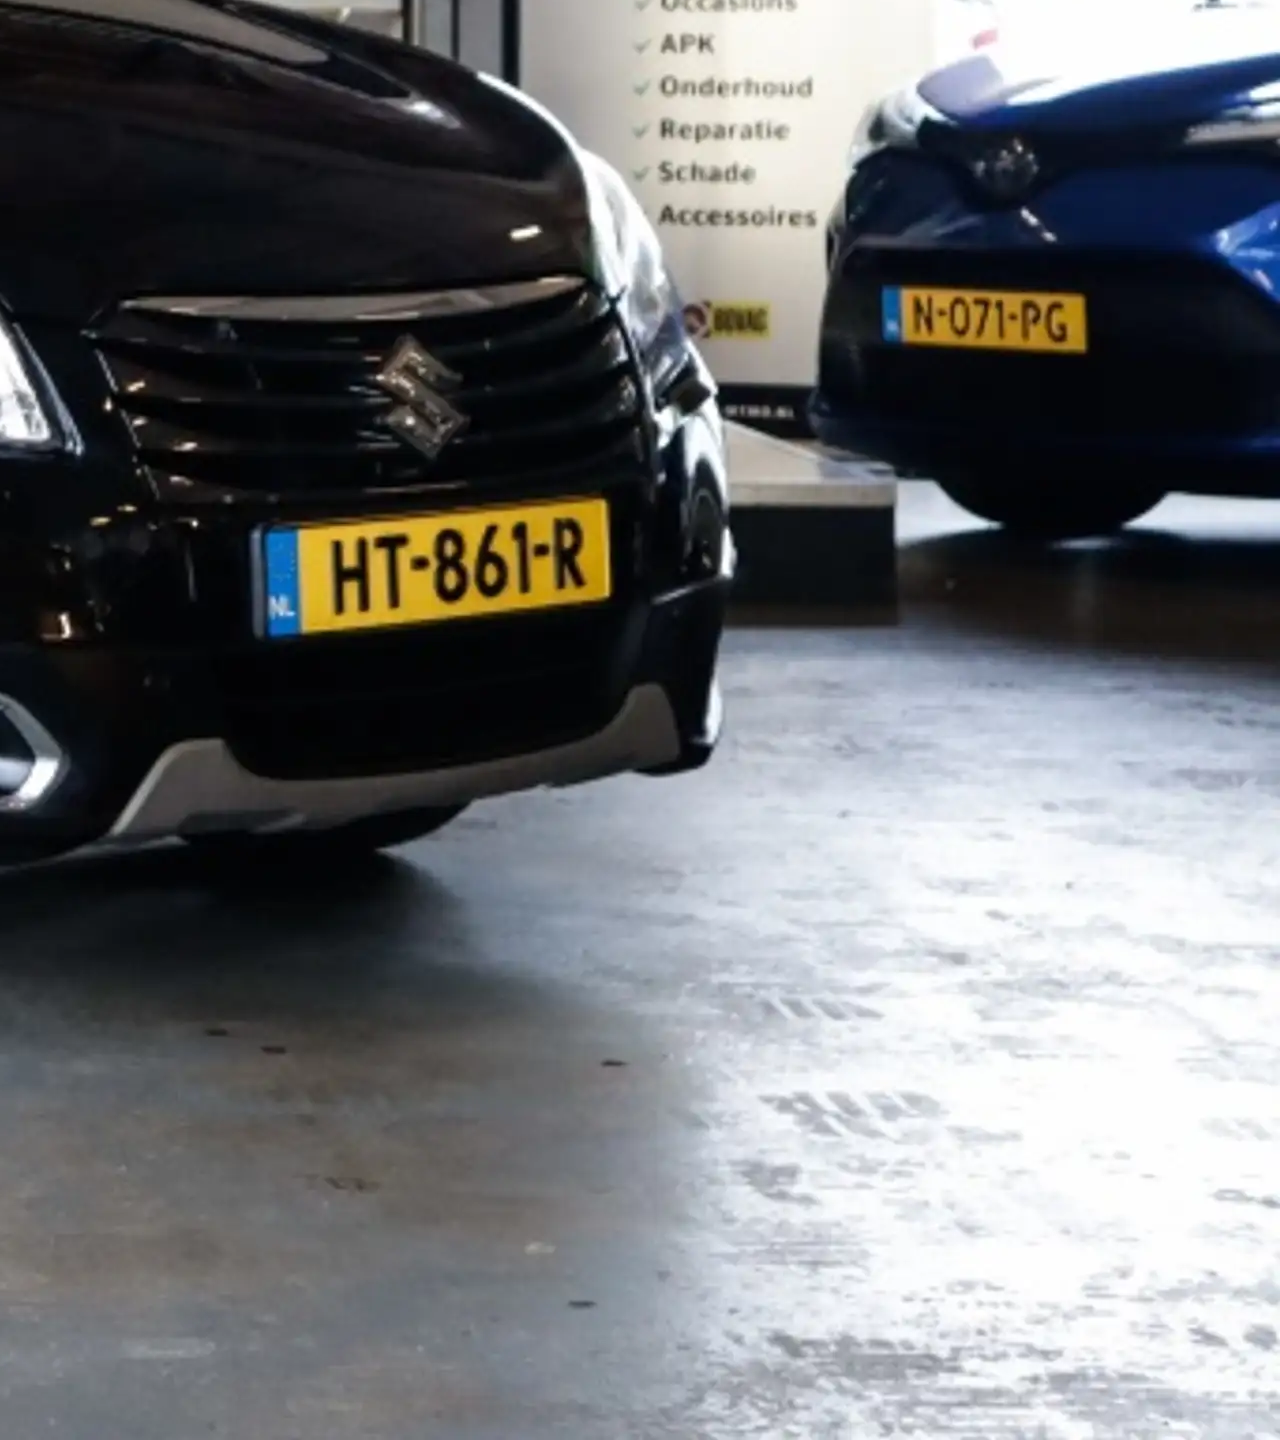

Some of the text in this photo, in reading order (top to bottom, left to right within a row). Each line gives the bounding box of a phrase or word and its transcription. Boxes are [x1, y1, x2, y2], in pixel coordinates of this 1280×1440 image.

[659, 32, 716, 55] APK
[658, 74, 814, 98] Onderhoud
[659, 118, 791, 145] Reparatie
[657, 160, 757, 185] Schade
[657, 203, 818, 229] Accessoires
[912, 295, 1068, 344] N-071-PG
[331, 517, 587, 616] HT-861-R
[268, 595, 295, 619] NL
